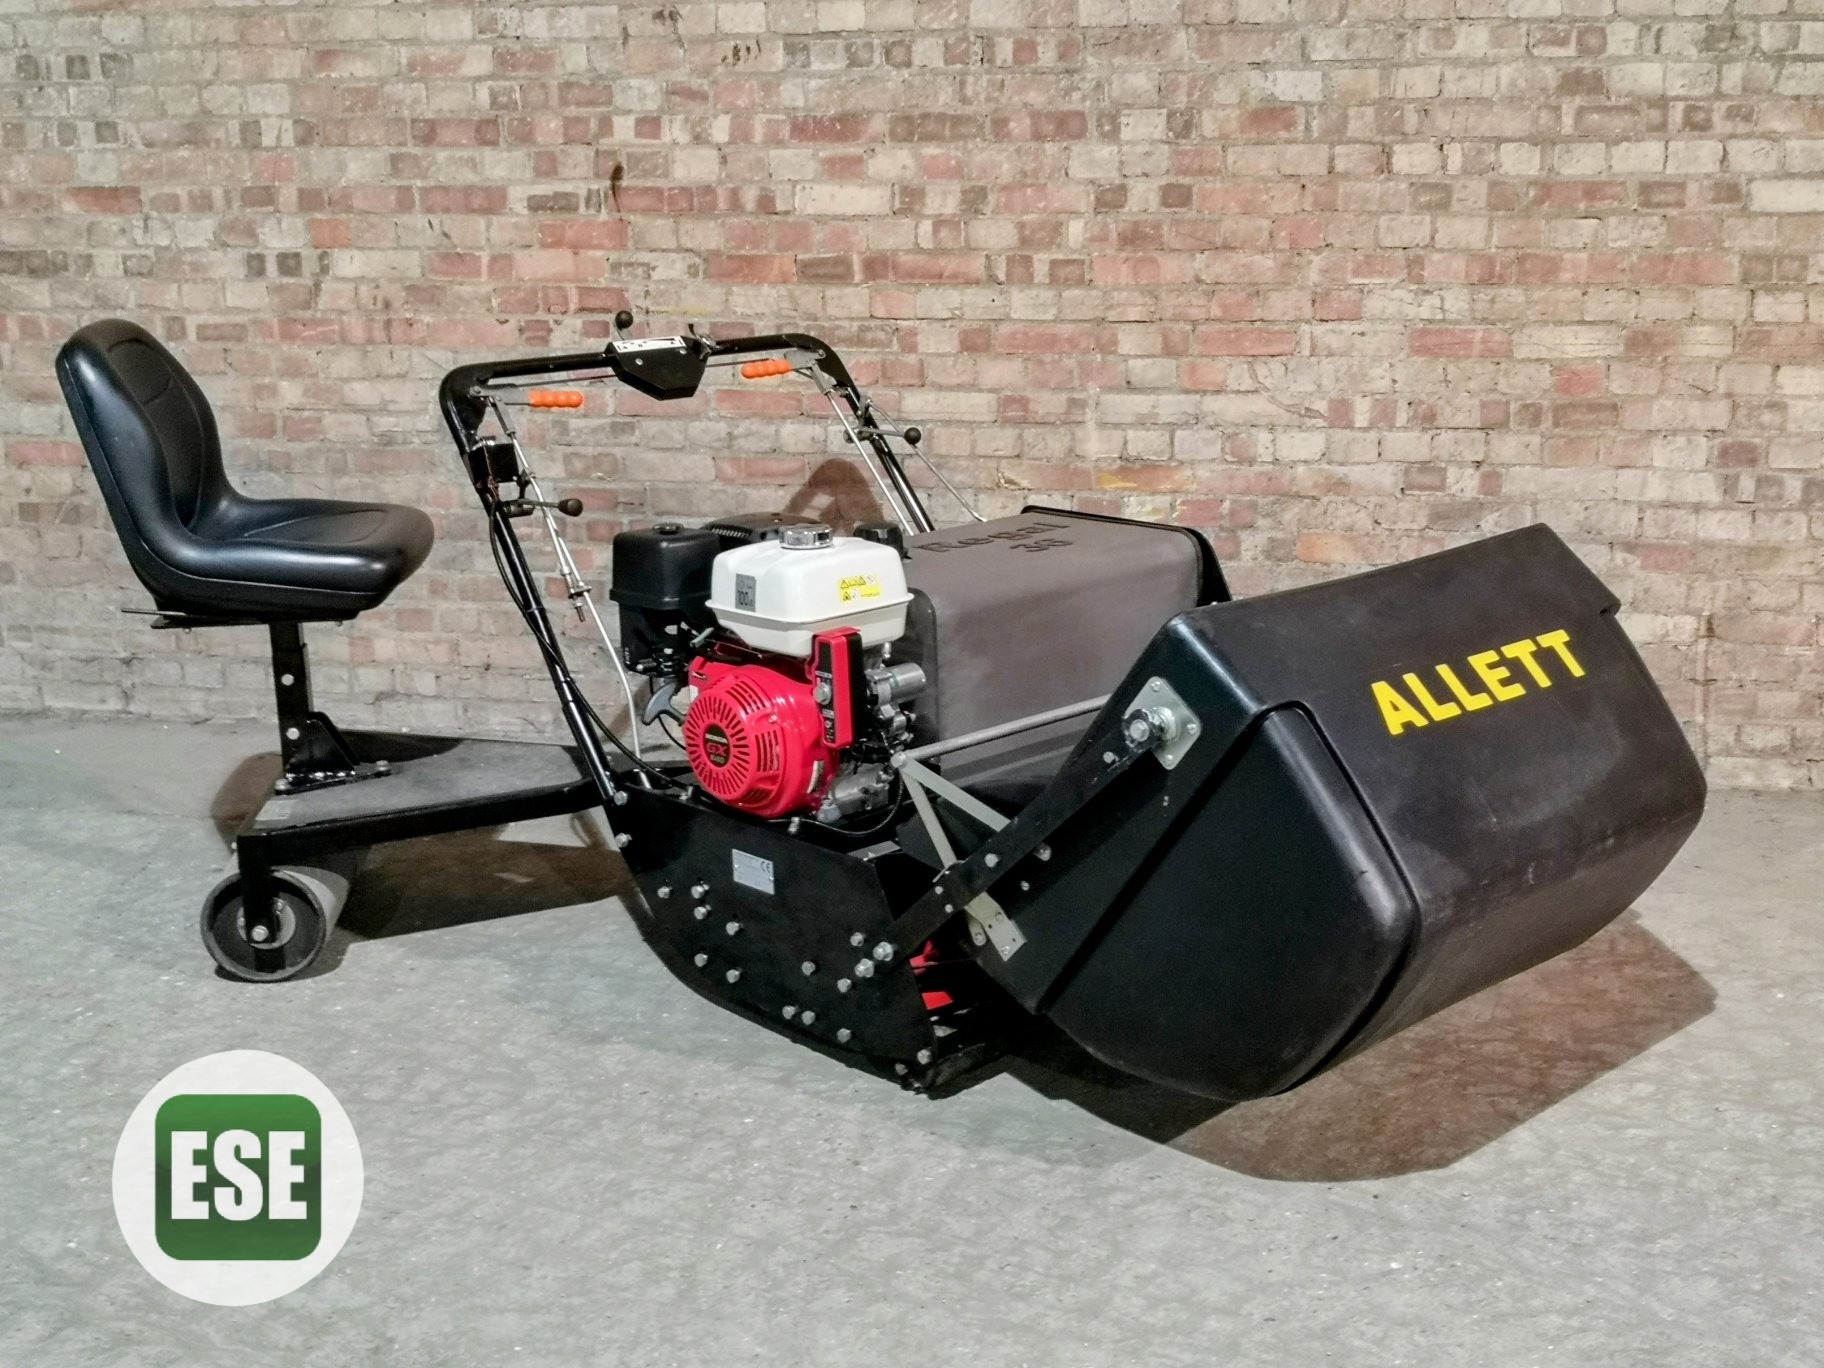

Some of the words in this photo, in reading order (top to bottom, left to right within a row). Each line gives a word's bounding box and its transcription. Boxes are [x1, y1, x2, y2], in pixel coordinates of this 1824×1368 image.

[912, 522, 1070, 553] Regal
[1371, 629, 1586, 736] ALLETT
[706, 742, 728, 756] GX
